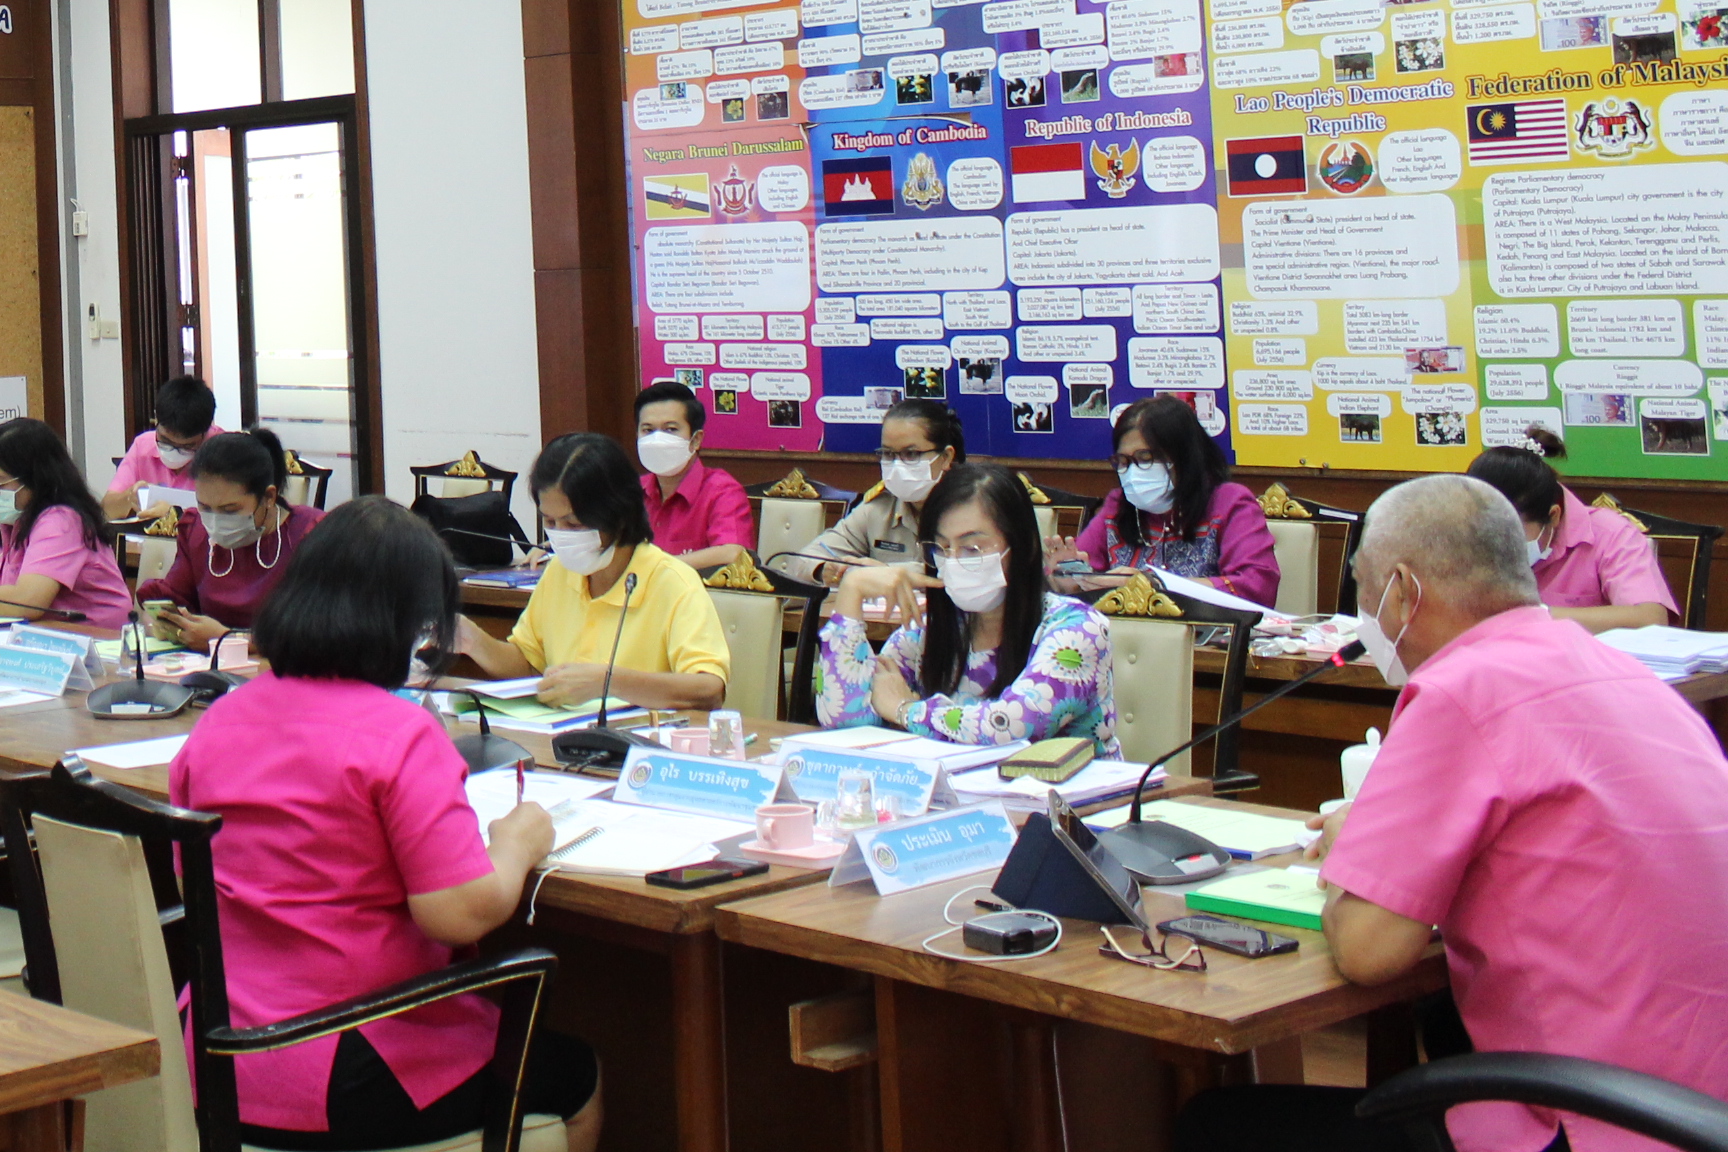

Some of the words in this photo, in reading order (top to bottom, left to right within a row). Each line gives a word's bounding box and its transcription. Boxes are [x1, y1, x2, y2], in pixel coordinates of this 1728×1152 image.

[1235, 92, 1268, 112] Lao
[1348, 79, 1454, 104] Democratic
[1467, 70, 1589, 98] Federation
[1600, 66, 1624, 89] of
[832, 132, 894, 151] Kingdom
[898, 130, 912, 144] of
[916, 124, 987, 145] Cambodia
[1026, 118, 1092, 138] Republic
[1096, 114, 1112, 132] of
[1116, 110, 1192, 129] Indonesia
[1307, 113, 1386, 135] Republic
[644, 148, 685, 164] Negara
[688, 144, 729, 158] Brunei
[732, 138, 804, 156] Darussalam
[660, 764, 680, 782] อุไร
[902, 827, 952, 852] ประเมิน
[960, 821, 986, 845] อุมา
